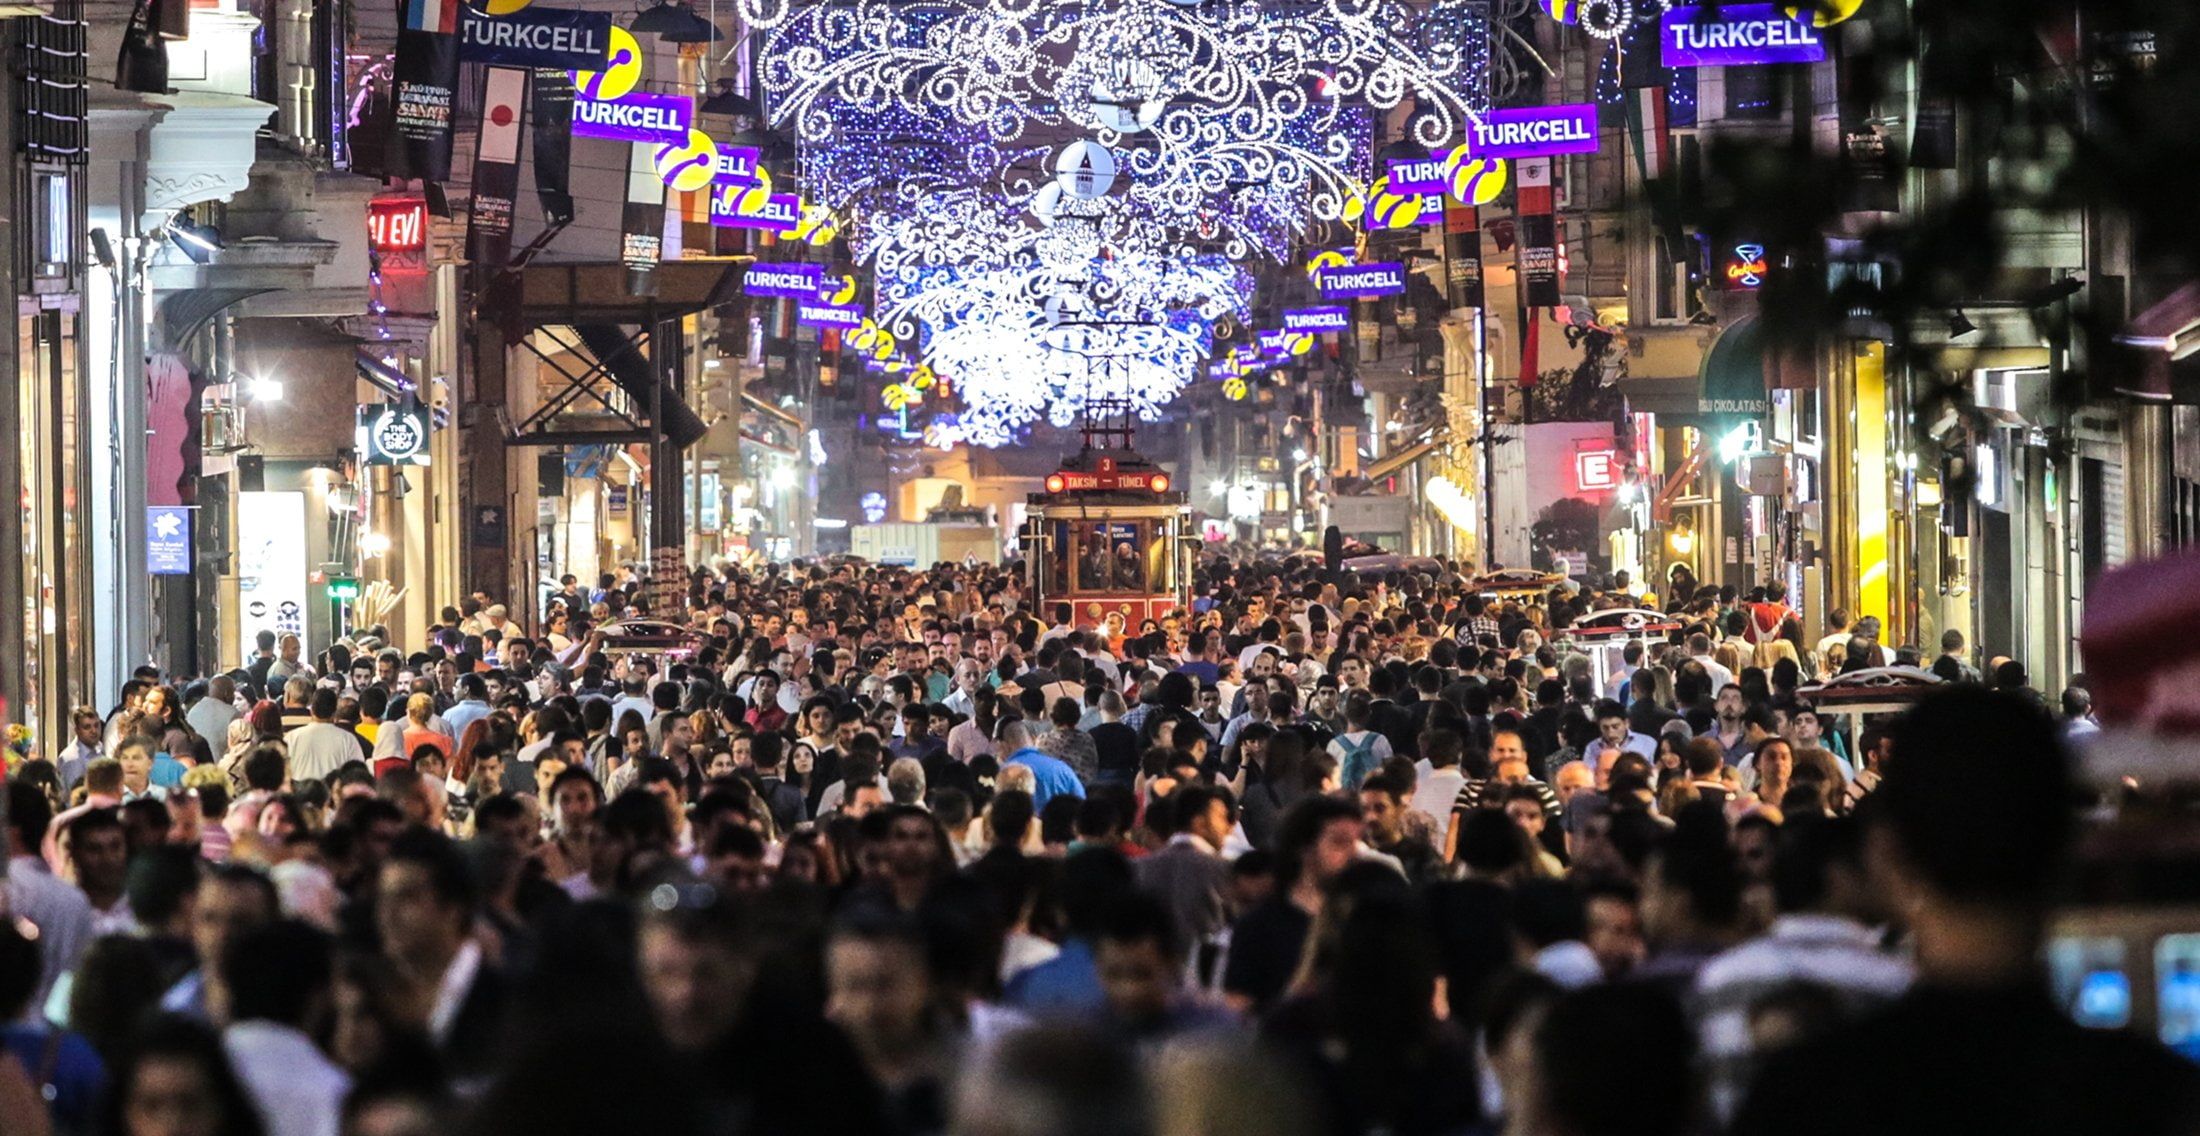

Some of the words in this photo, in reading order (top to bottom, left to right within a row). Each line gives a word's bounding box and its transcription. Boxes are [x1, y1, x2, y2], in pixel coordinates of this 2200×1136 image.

[462, 19, 601, 54] TURKCELL
[1669, 19, 1818, 50] TURKCELL
[572, 100, 683, 131] TURKCELL
[1473, 117, 1591, 146] TURKCELL
[744, 271, 816, 291] TURKCELL
[1323, 271, 1402, 290] TURKCELL
[800, 306, 861, 324] TURKCELL
[1285, 312, 1347, 328] TURKCELL
[383, 431, 413, 442] BODY
[389, 424, 407, 433] THE
[384, 440, 412, 450] SHOP
[1103, 459, 1110, 472] 3
